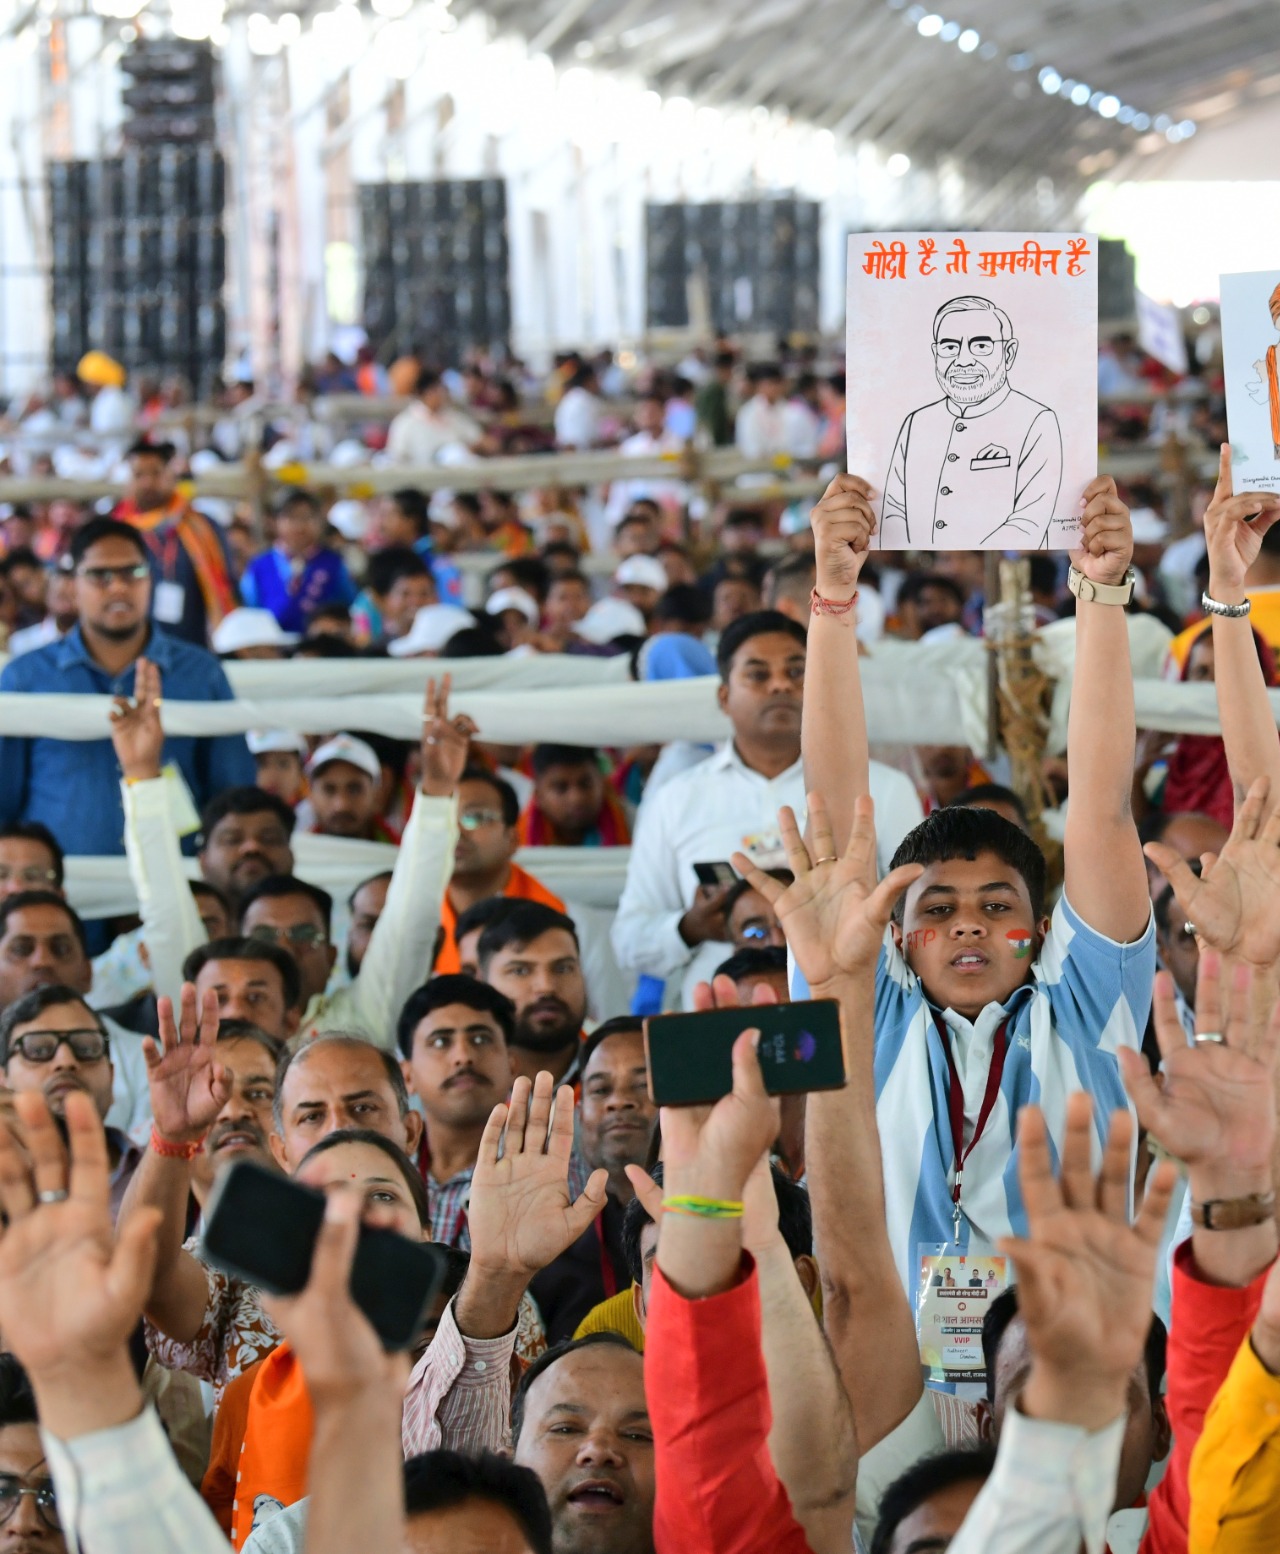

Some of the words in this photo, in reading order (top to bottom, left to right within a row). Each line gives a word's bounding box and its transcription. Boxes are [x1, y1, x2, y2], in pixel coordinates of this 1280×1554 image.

[862, 240, 909, 279] मोदी
[917, 238, 938, 276] है
[945, 238, 971, 274] तो
[977, 240, 1062, 277] मुमकीन
[1066, 238, 1091, 276] है
[954, 1336, 971, 1344] VVIP
